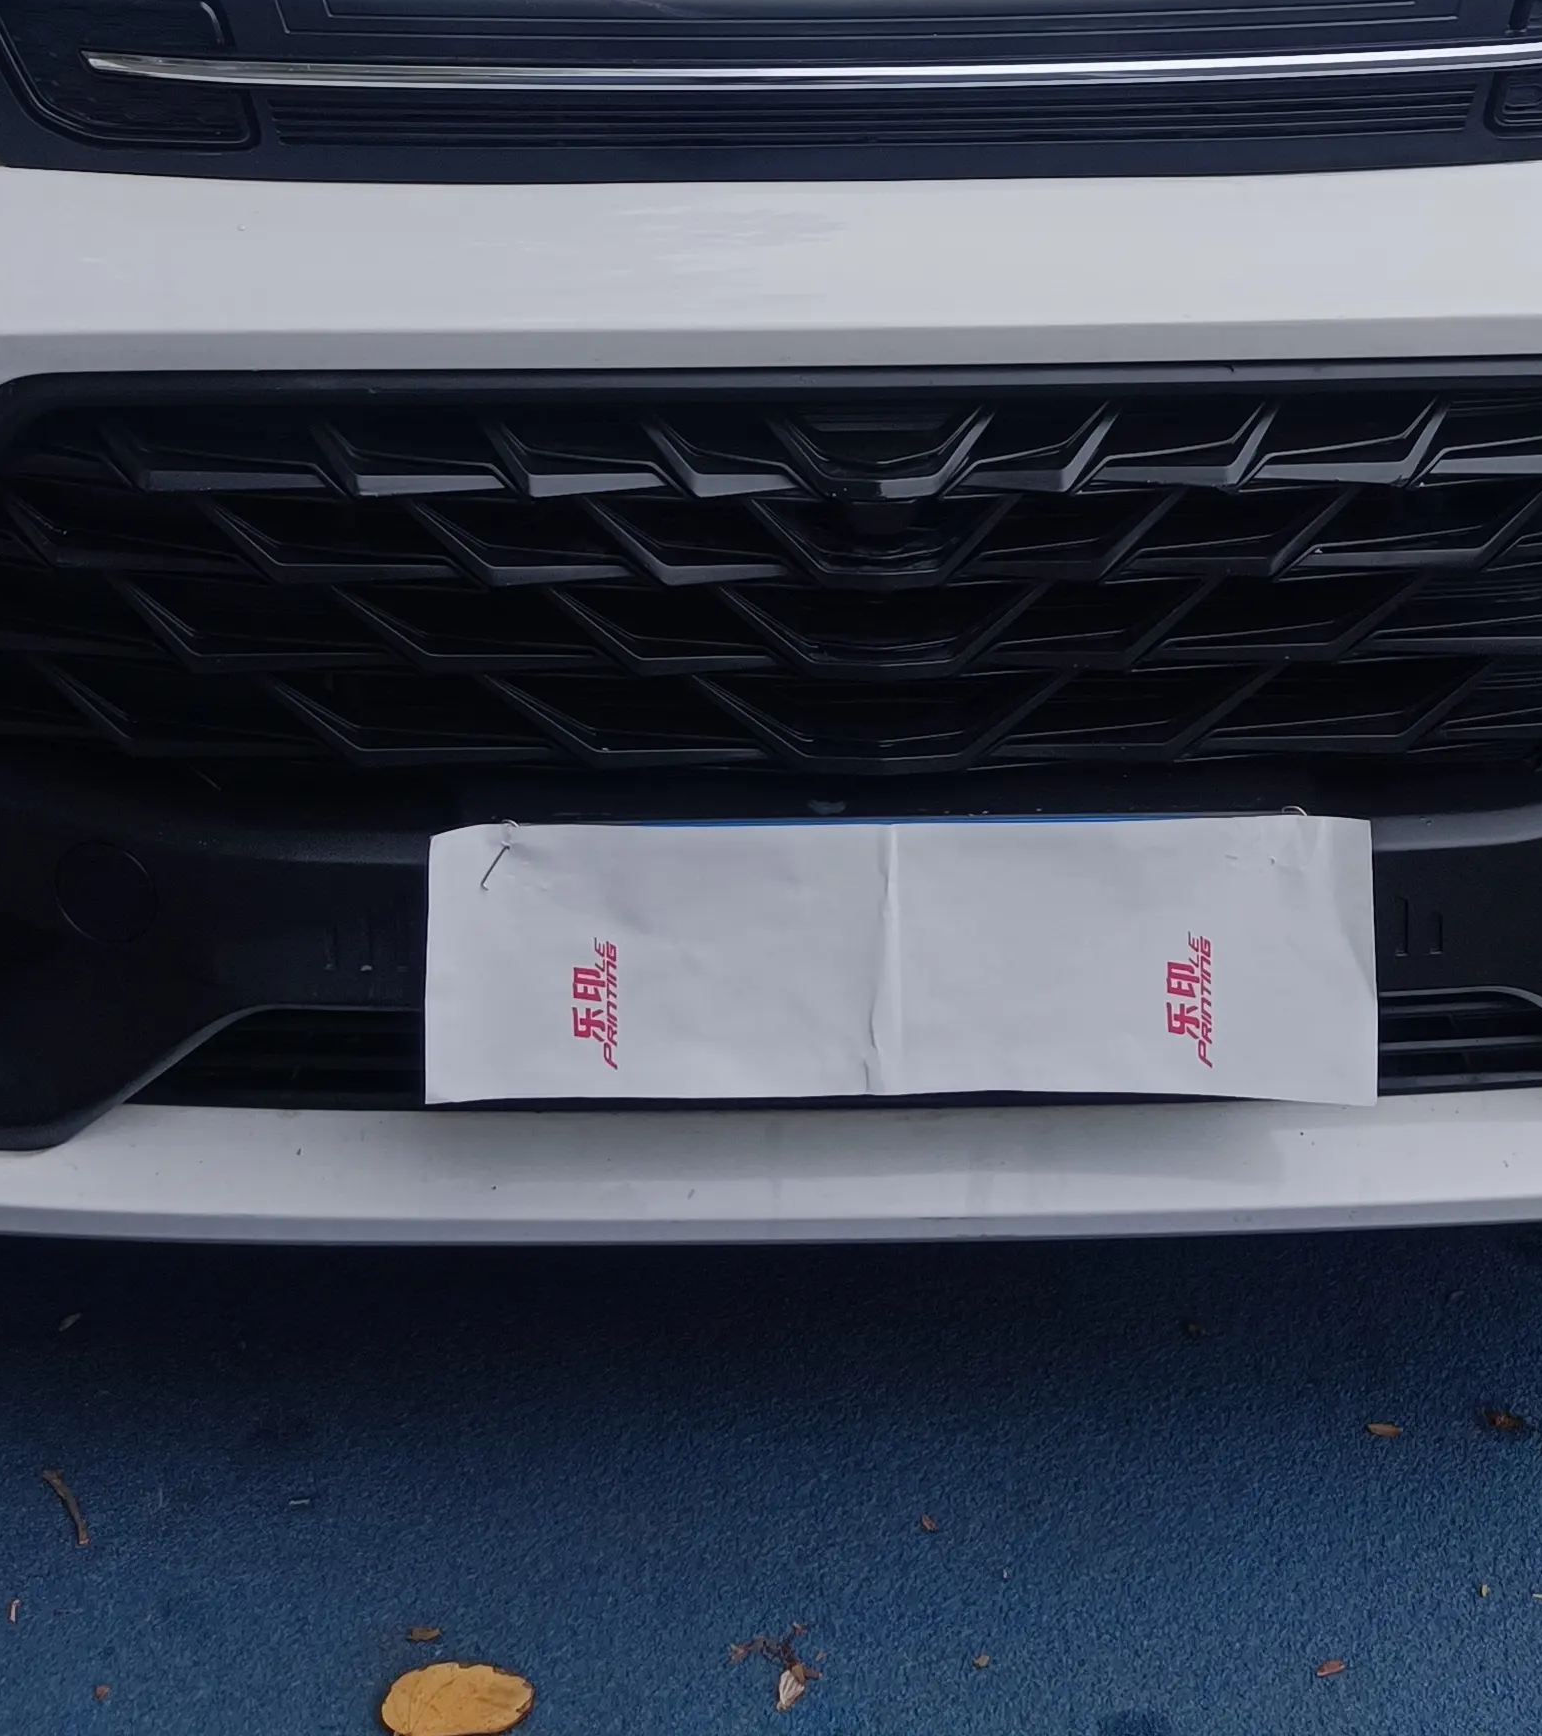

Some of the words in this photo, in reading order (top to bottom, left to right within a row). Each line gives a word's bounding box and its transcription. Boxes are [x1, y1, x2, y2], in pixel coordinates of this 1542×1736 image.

[594, 937, 606, 973] LE
[1188, 931, 1200, 968] LE
[571, 967, 606, 1042] 乐印
[603, 941, 618, 1070] PRINTING
[1166, 961, 1200, 1039] 乐印
[1198, 936, 1213, 1068] PRINTING
